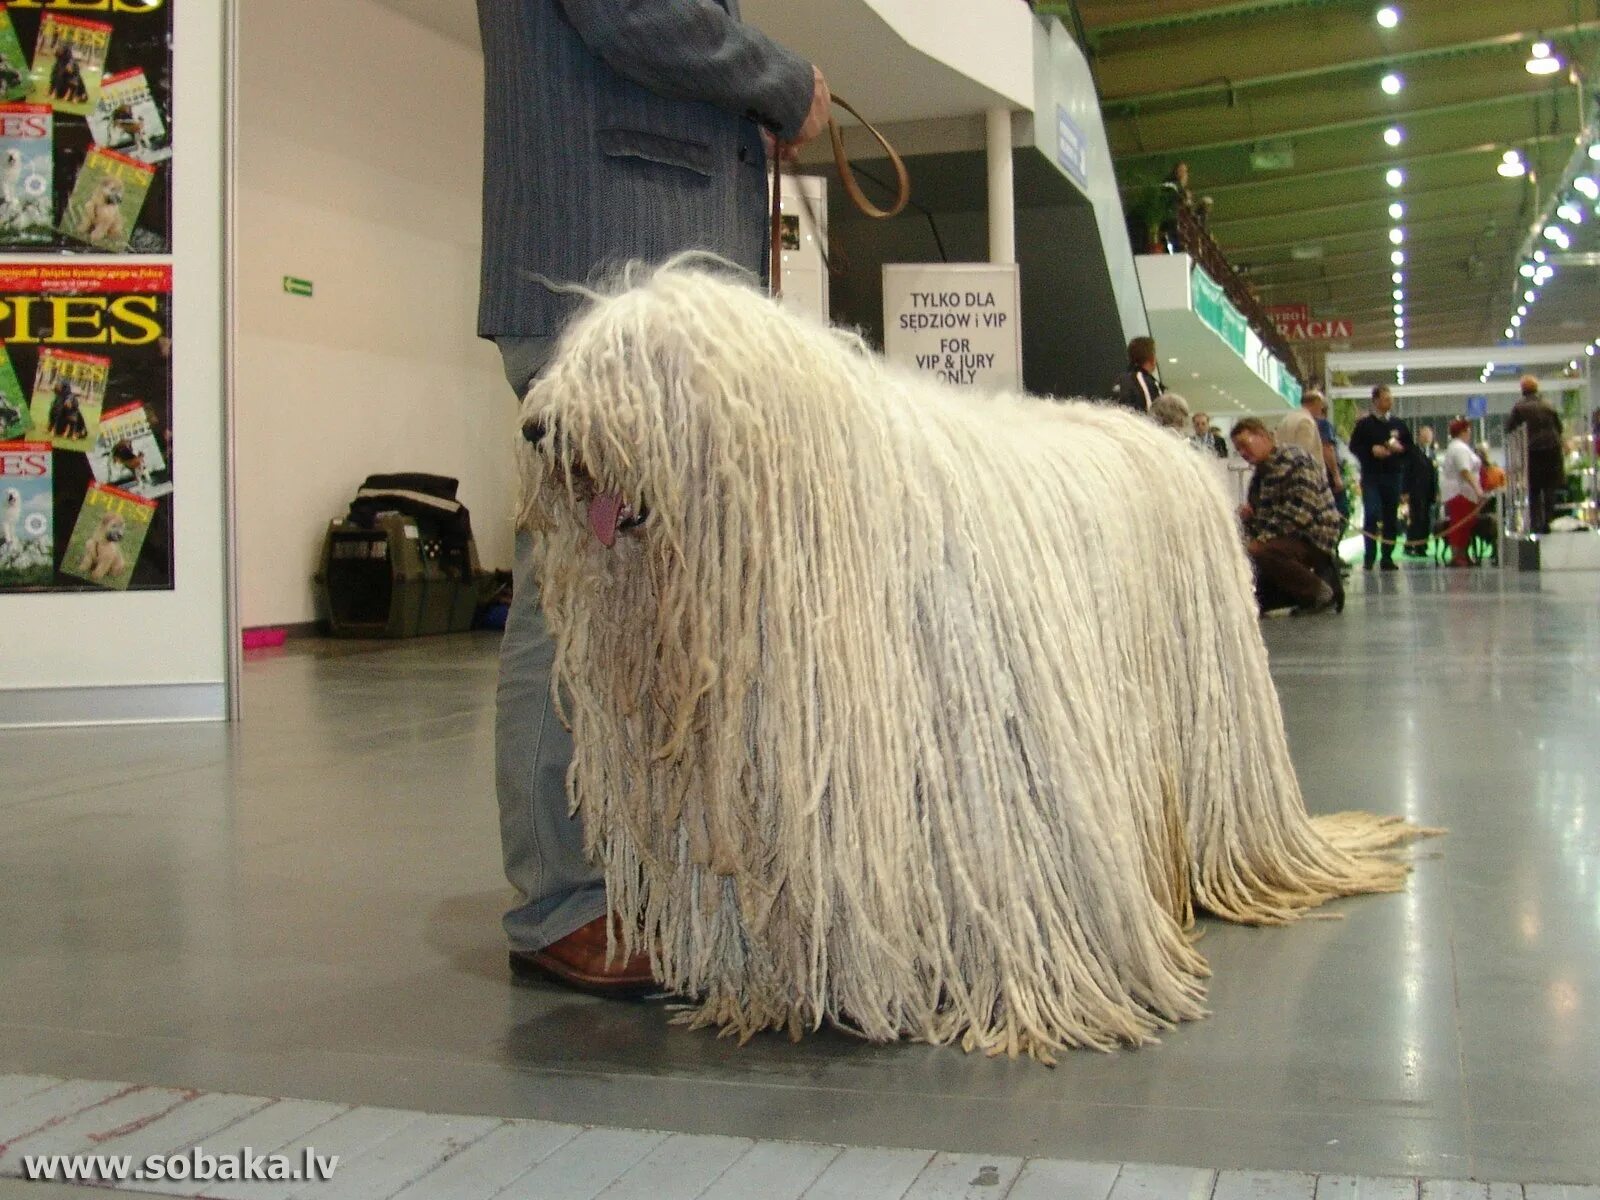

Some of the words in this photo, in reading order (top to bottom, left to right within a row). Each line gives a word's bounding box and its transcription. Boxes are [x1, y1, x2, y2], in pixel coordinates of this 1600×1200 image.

[910, 292, 960, 308] TYLKO
[965, 292, 995, 307] DLA
[983, 312, 1007, 328] VIP
[940, 338, 970, 353] FOR
[916, 354, 940, 369] VIP
[944, 354, 955, 369] &
[960, 354, 995, 371] JURY
